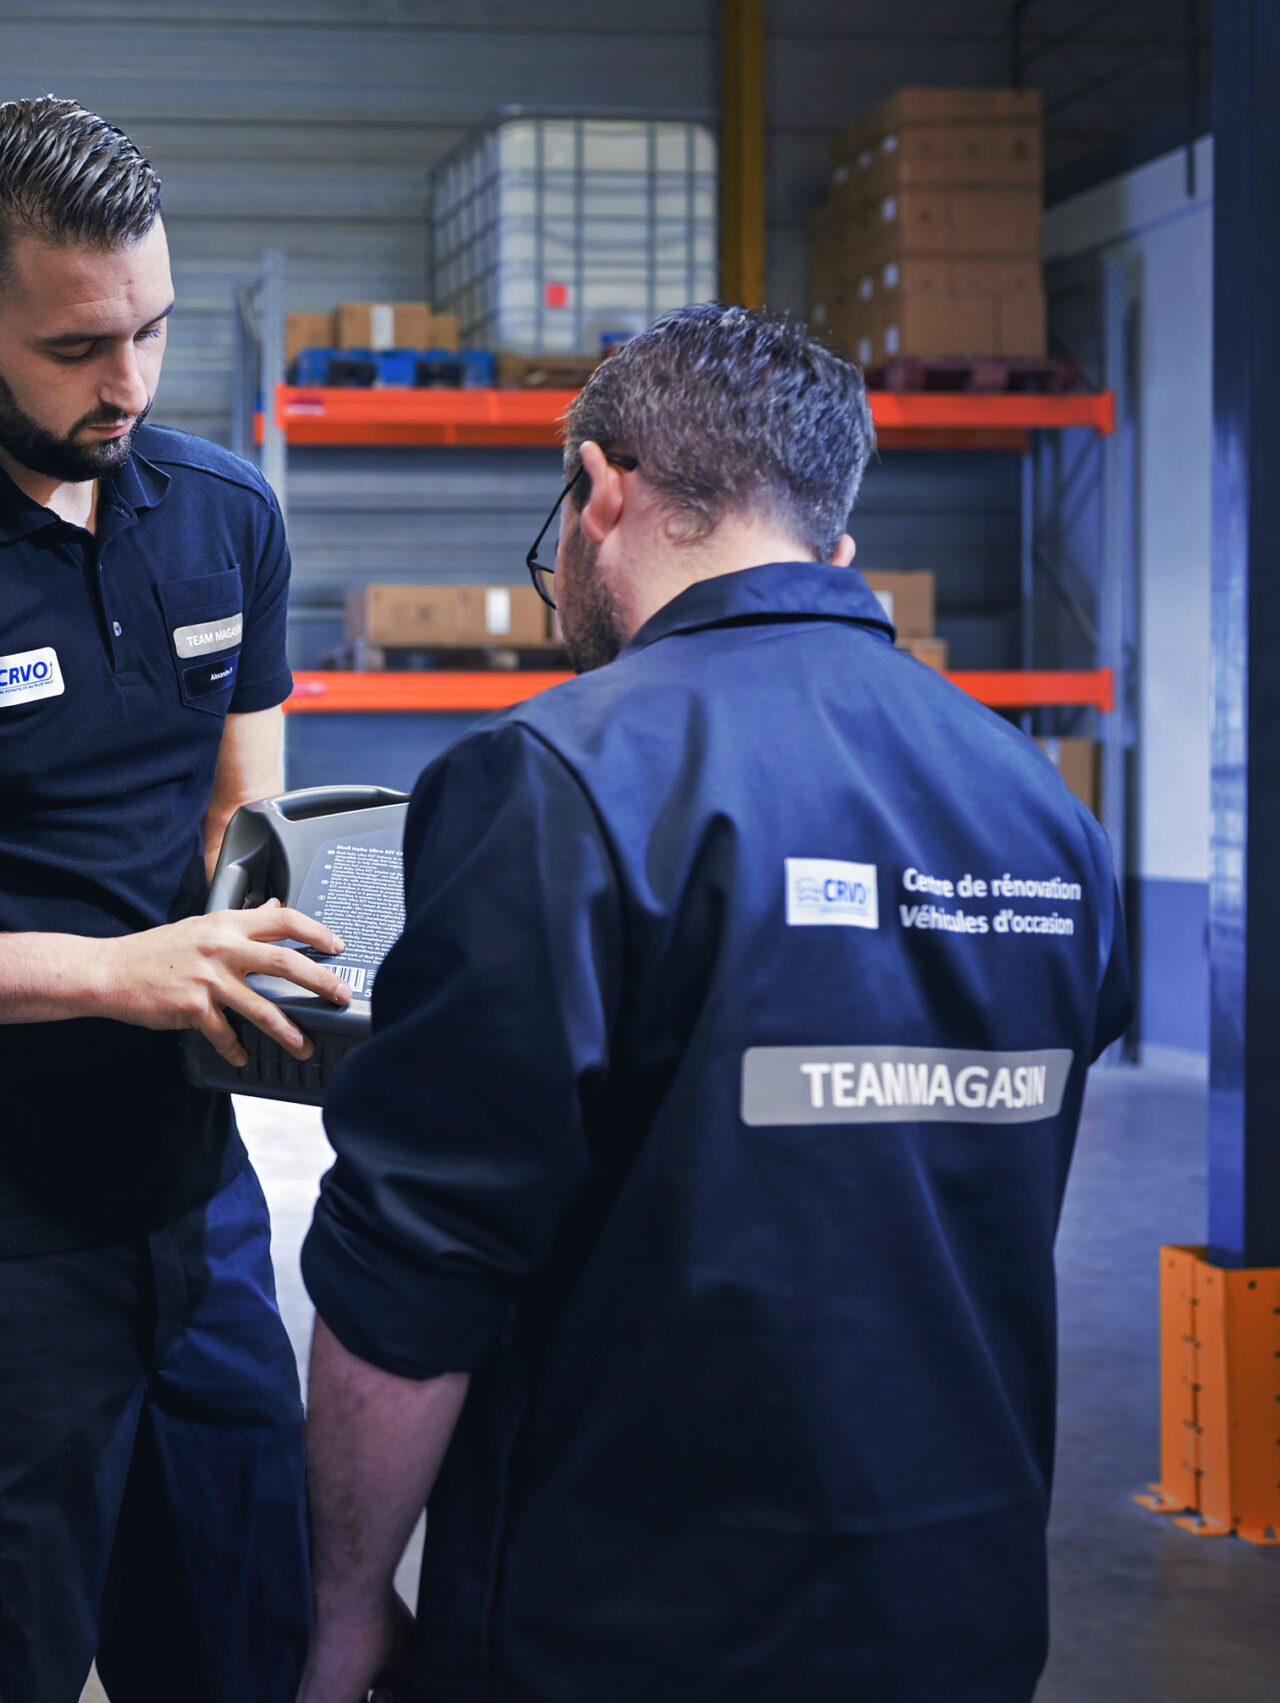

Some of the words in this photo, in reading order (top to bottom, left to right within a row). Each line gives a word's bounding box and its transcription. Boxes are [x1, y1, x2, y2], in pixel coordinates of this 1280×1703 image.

[186, 632, 214, 647] TEAM
[823, 879, 867, 905] CRVO
[956, 873, 988, 898] de
[990, 872, 1082, 901] rénovation
[899, 904, 990, 934] Véhicules
[992, 909, 1074, 936] d'occasion
